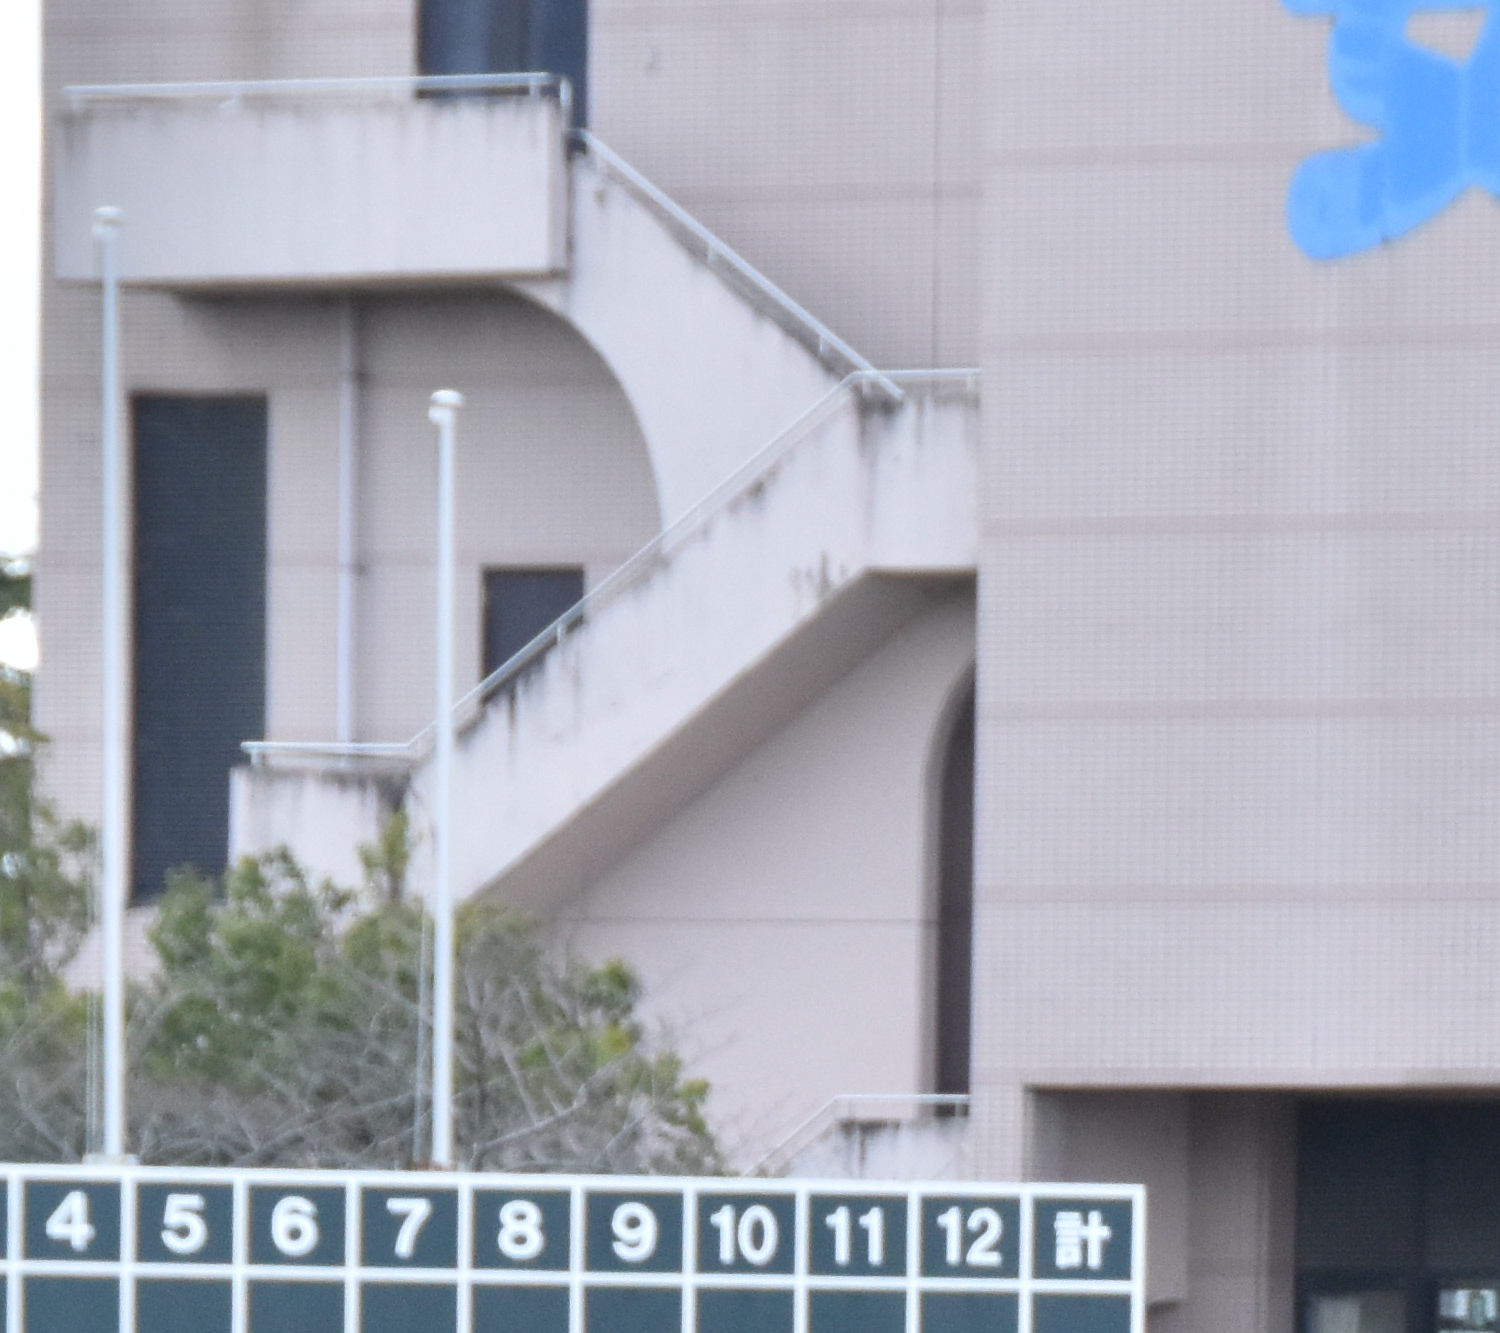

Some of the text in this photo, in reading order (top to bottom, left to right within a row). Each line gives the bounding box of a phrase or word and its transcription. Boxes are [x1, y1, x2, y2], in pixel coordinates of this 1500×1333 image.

[45, 1190, 95, 1251] 4
[161, 1193, 208, 1254] 5
[271, 1195, 318, 1256] 6
[386, 1197, 431, 1258] 7
[497, 1199, 544, 1260] 8
[611, 1201, 658, 1262] 9
[710, 1204, 778, 1266] 10
[825, 1206, 884, 1266] 11
[937, 1206, 1003, 1267] 12
[1053, 1210, 1112, 1270] 計
